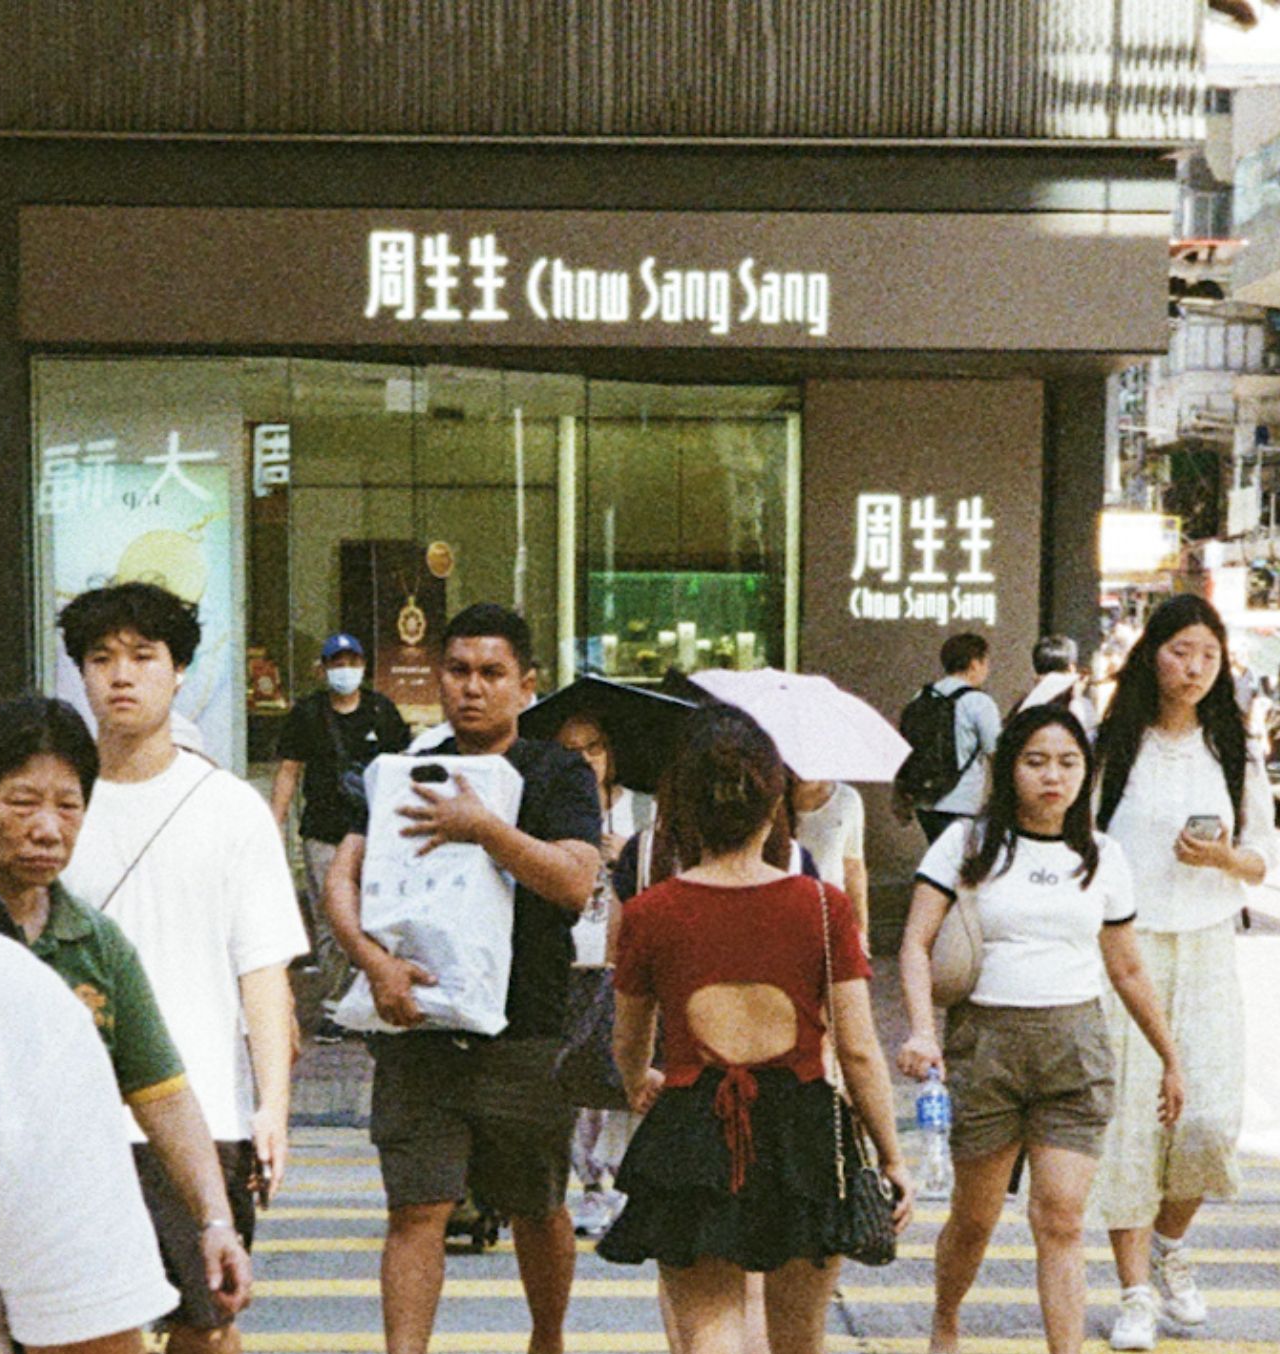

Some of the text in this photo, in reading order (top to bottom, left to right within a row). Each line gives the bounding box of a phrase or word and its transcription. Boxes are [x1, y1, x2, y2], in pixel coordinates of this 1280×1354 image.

[364, 230, 829, 336] 周生生 Chow Sang Sang
[850, 493, 995, 583] 周生生
[849, 586, 996, 626] Chow Sang Sang
[1029, 866, 1058, 887] alo
